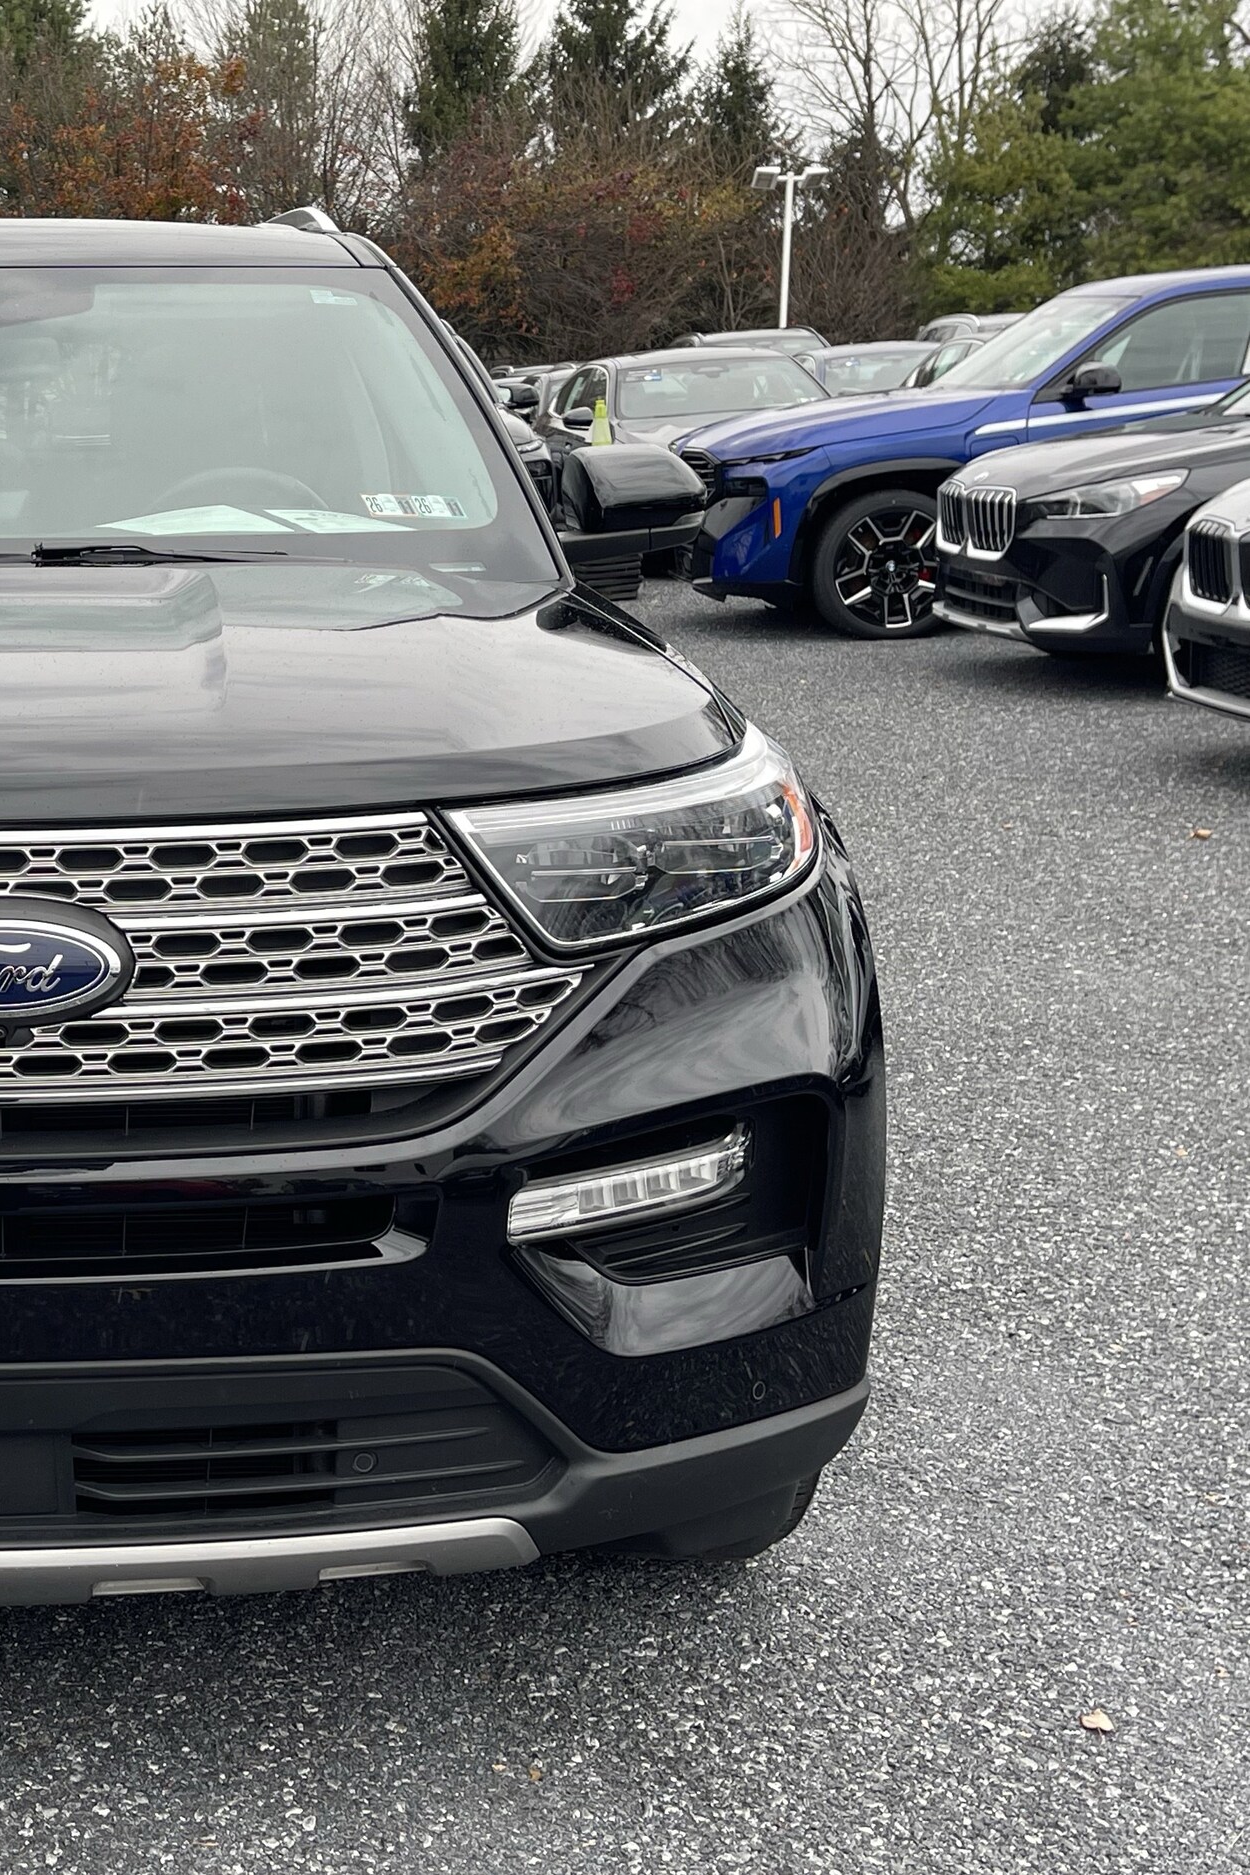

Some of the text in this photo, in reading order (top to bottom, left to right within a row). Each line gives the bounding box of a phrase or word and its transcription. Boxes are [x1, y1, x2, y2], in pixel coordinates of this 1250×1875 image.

[365, 496, 417, 515] 26 11
[414, 497, 465, 517] 26 11
